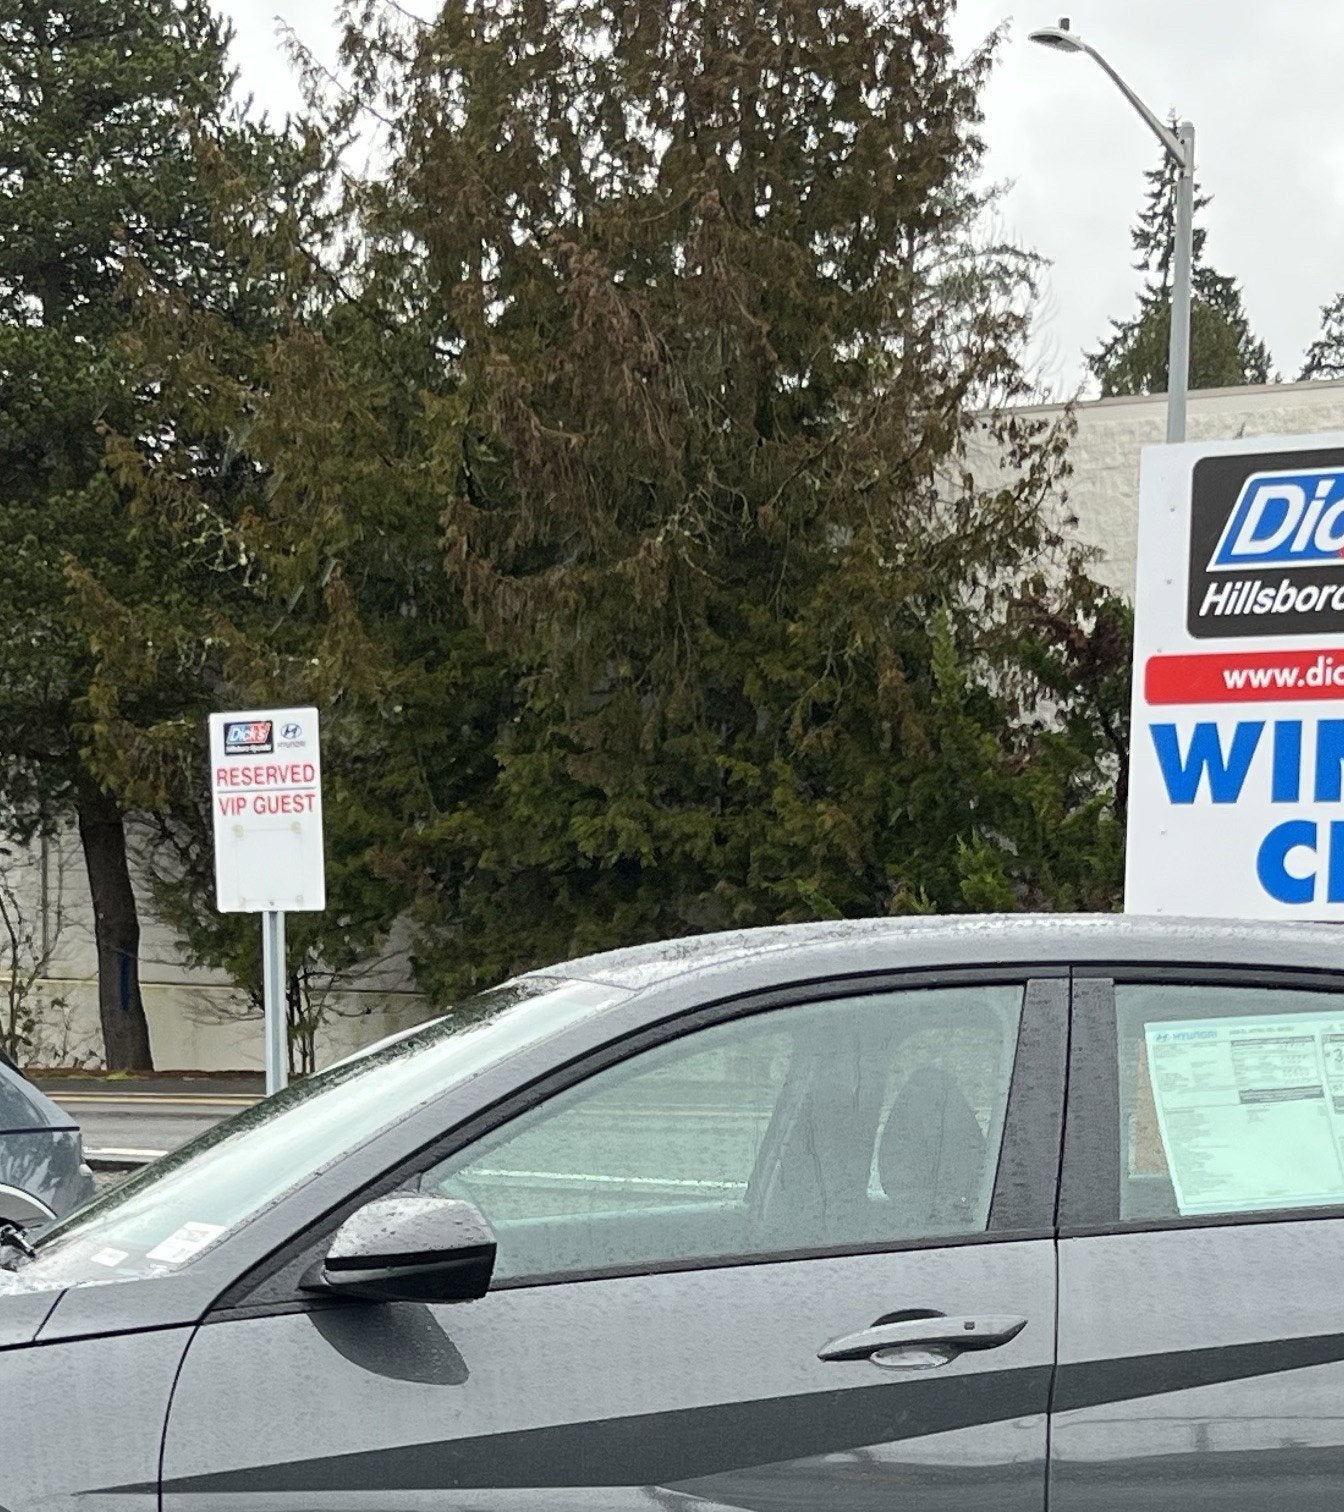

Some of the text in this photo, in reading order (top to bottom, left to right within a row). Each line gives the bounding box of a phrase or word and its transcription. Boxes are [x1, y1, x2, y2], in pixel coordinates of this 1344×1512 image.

[216, 764, 316, 786] RESERVED
[218, 794, 316, 816] VIP GUEST
